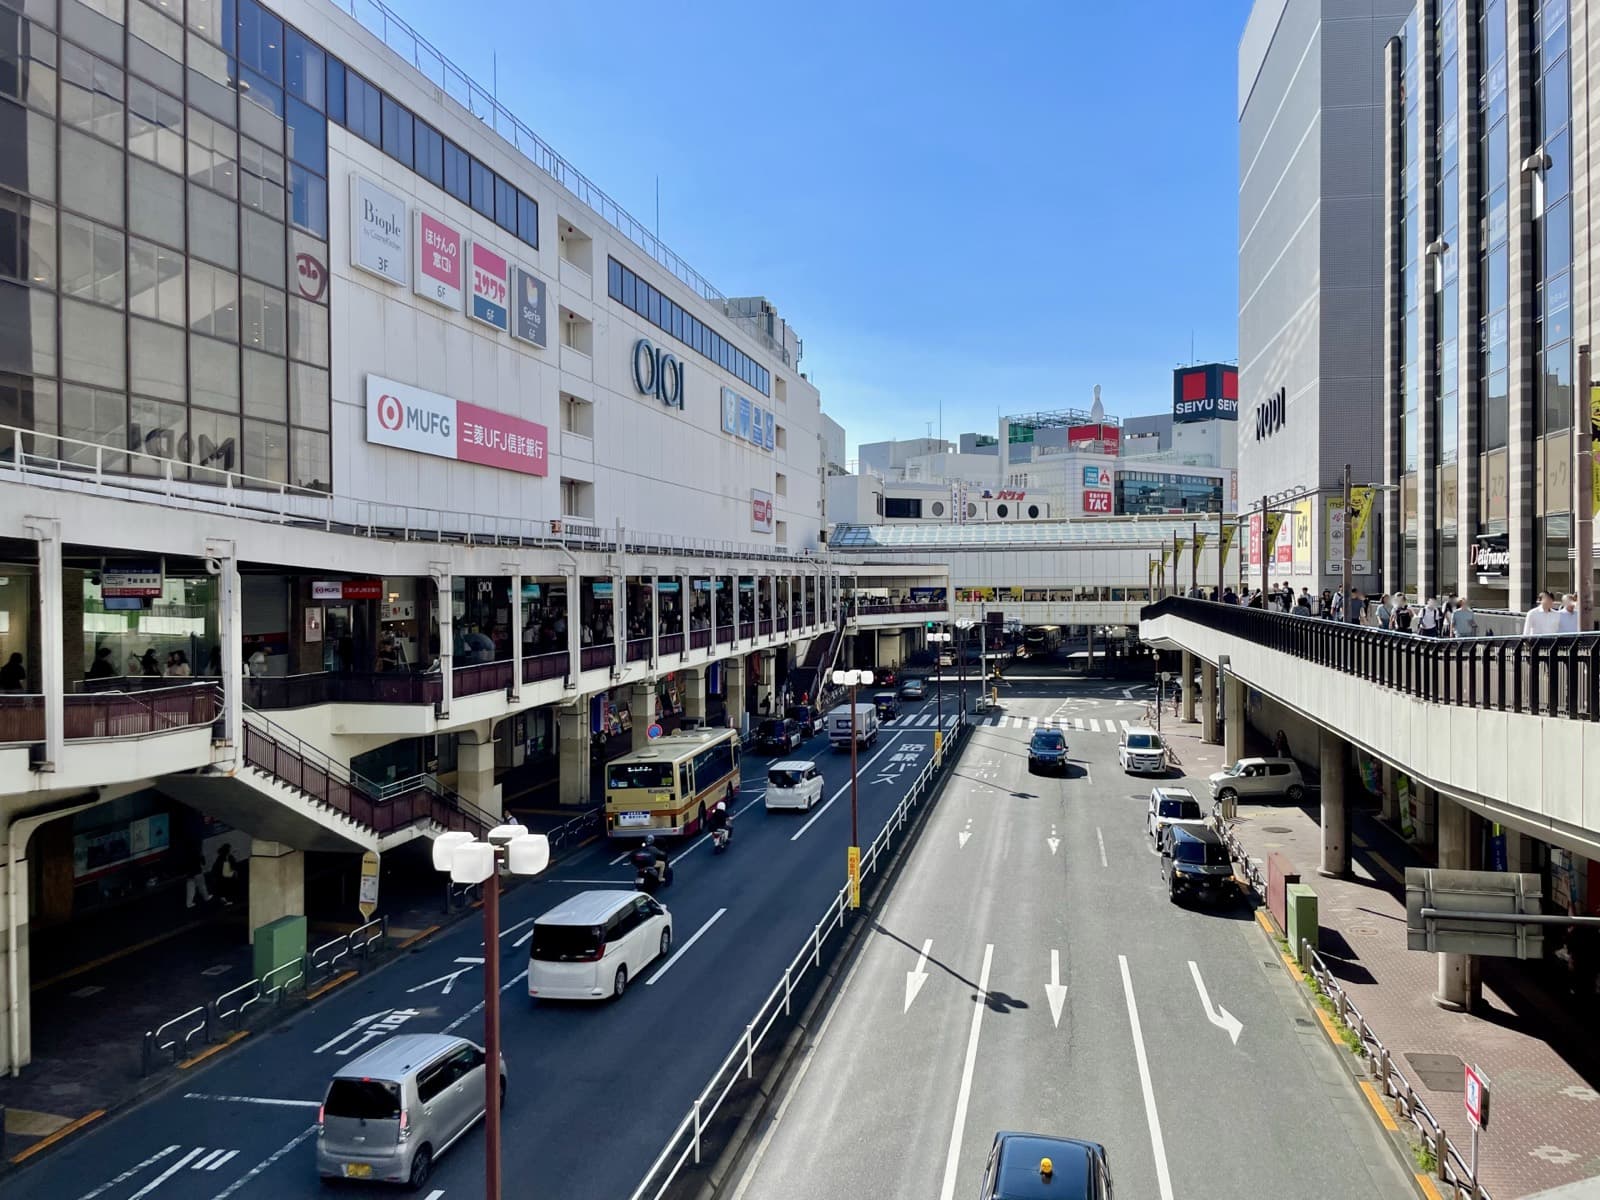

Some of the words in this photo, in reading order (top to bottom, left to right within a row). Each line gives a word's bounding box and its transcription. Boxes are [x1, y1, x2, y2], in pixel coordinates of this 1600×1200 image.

[364, 198, 401, 237] Biople
[425, 227, 457, 257] ほけんの
[378, 256, 389, 272] 3F
[437, 285, 446, 298] 6F
[486, 308, 495, 321] 6F
[523, 306, 541, 325] Seria
[1175, 398, 1214, 414] SEIYU
[1217, 398, 1238, 411] SEIY
[406, 406, 451, 438] MUFG
[1256, 386, 1286, 442] MODI
[463, 421, 543, 460] 三菱UFJ信託銀行
[1089, 499, 1108, 511] TAC
